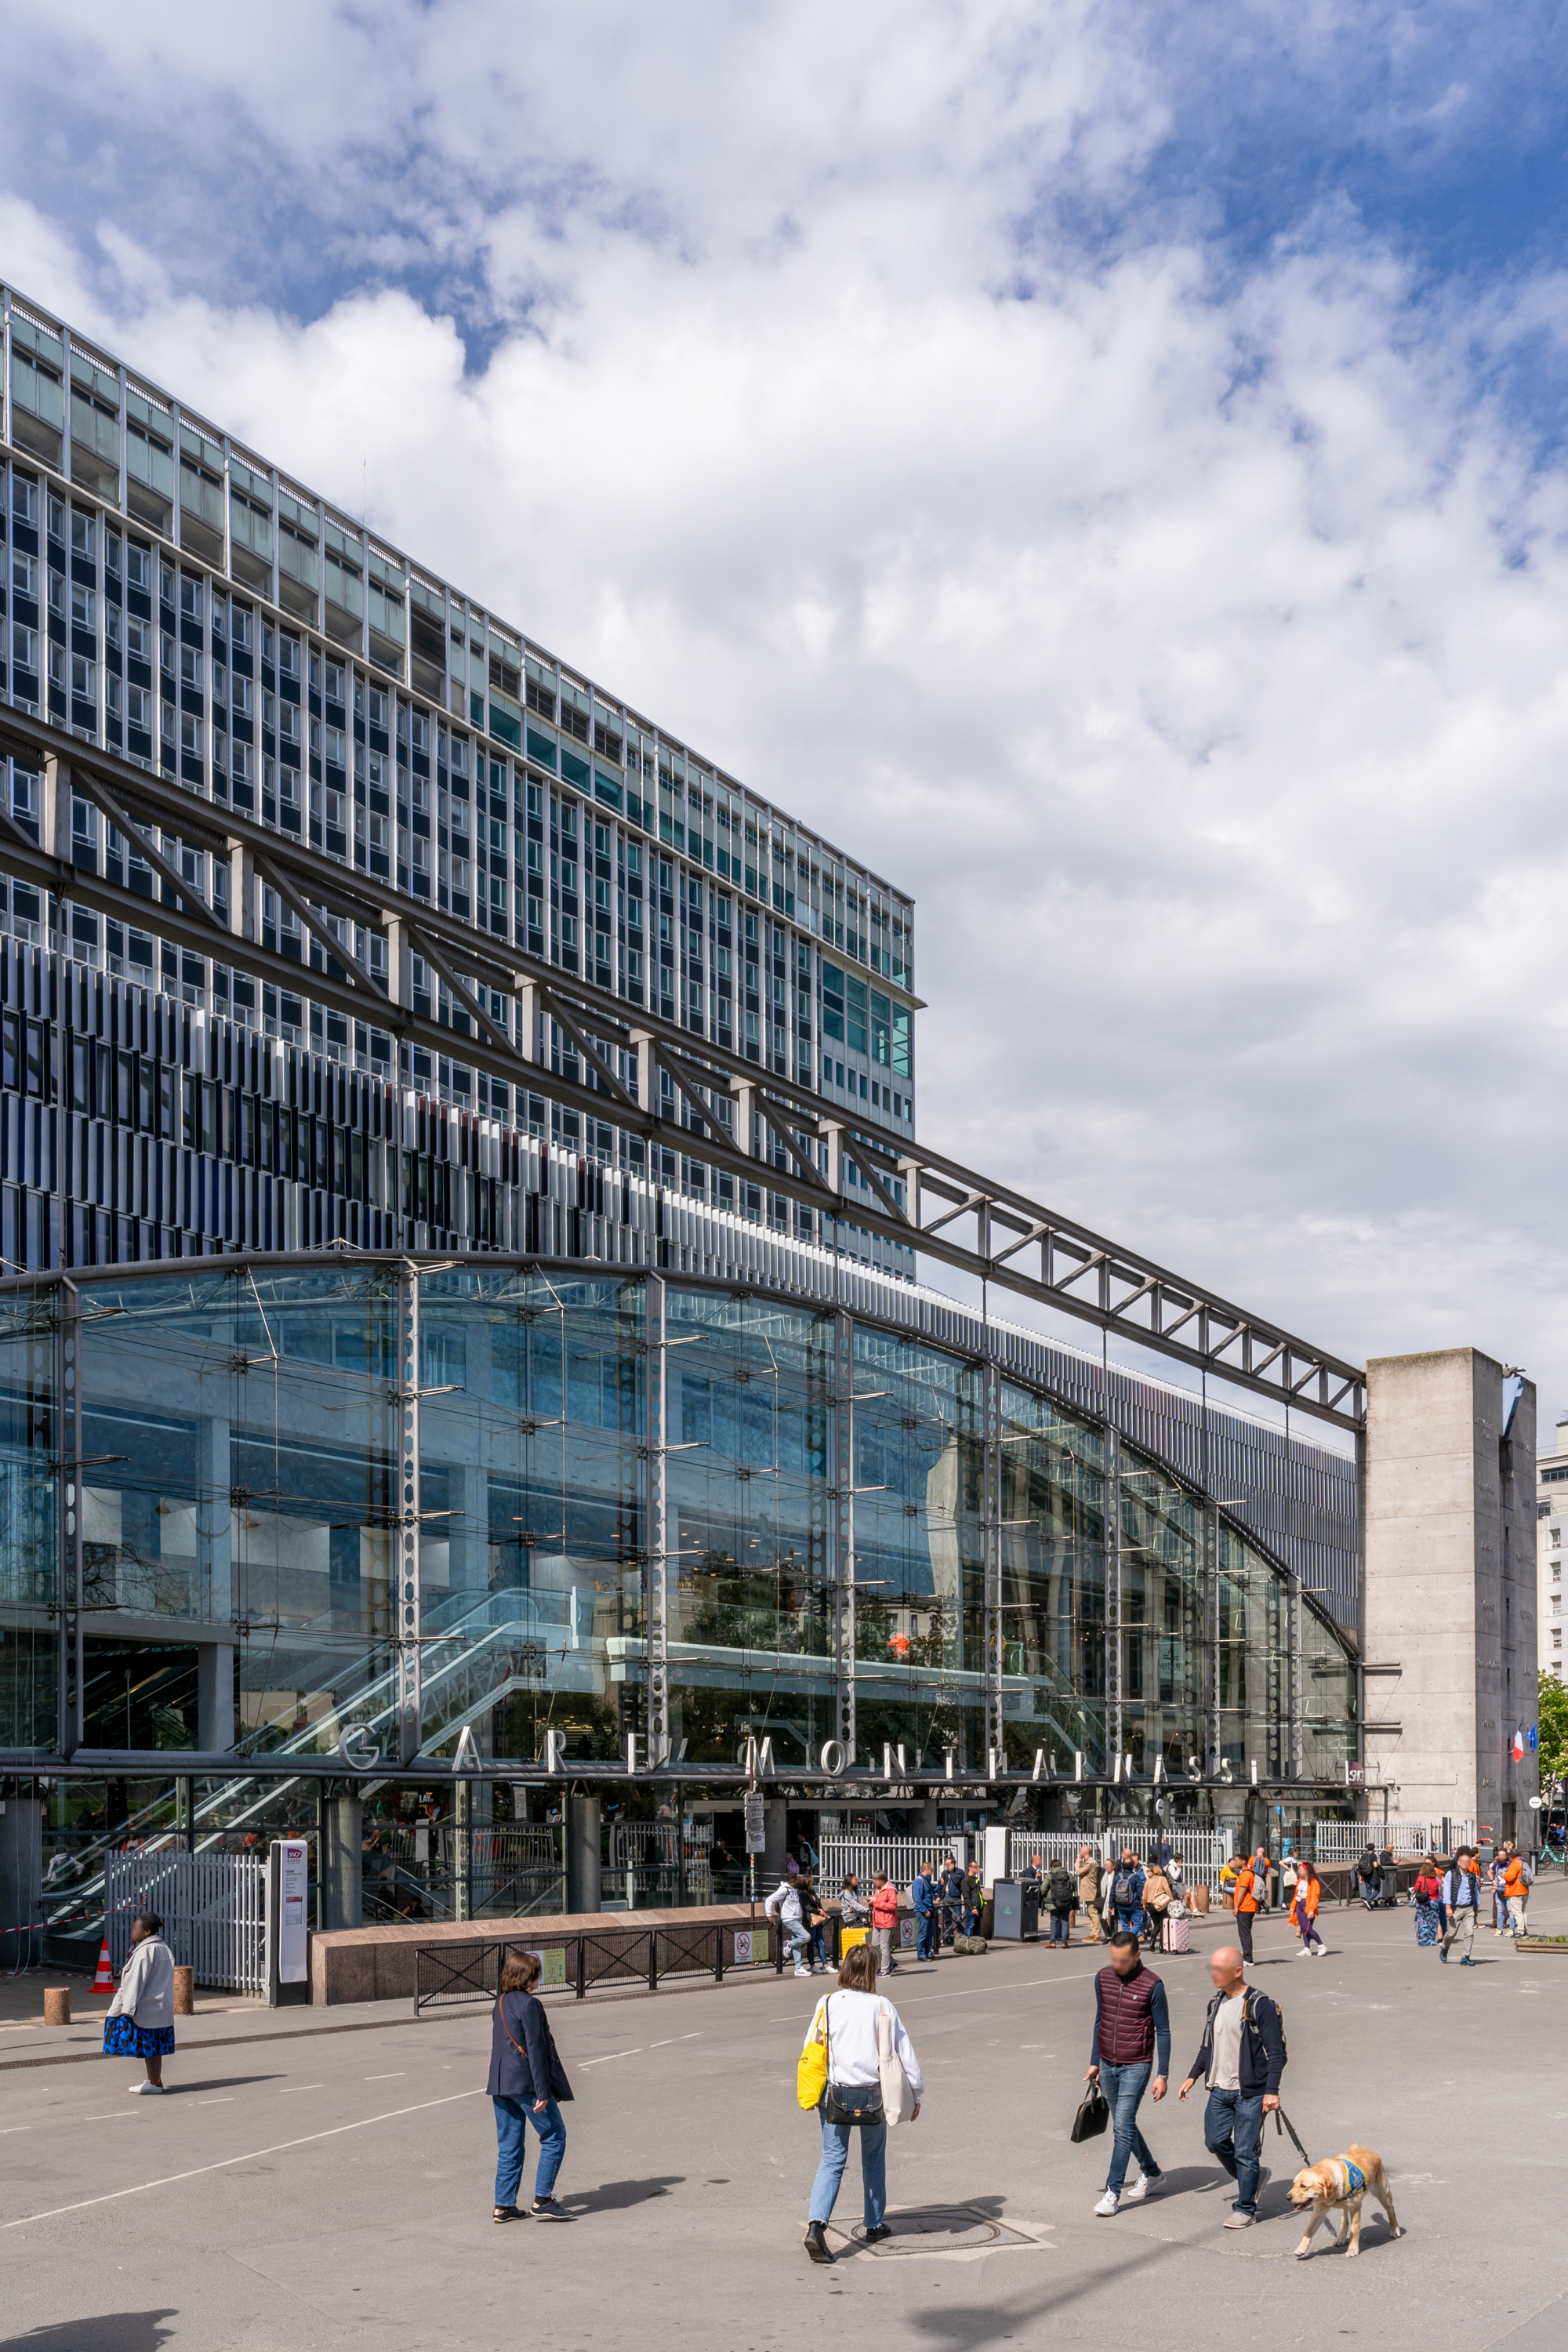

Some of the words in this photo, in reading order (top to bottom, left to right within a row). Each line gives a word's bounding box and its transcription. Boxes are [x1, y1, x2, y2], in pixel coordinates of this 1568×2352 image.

[1159, 1661, 1171, 1671] AINT
[339, 1722, 646, 1774] GARE
[745, 1737, 1262, 1785] MONTPARNASSE
